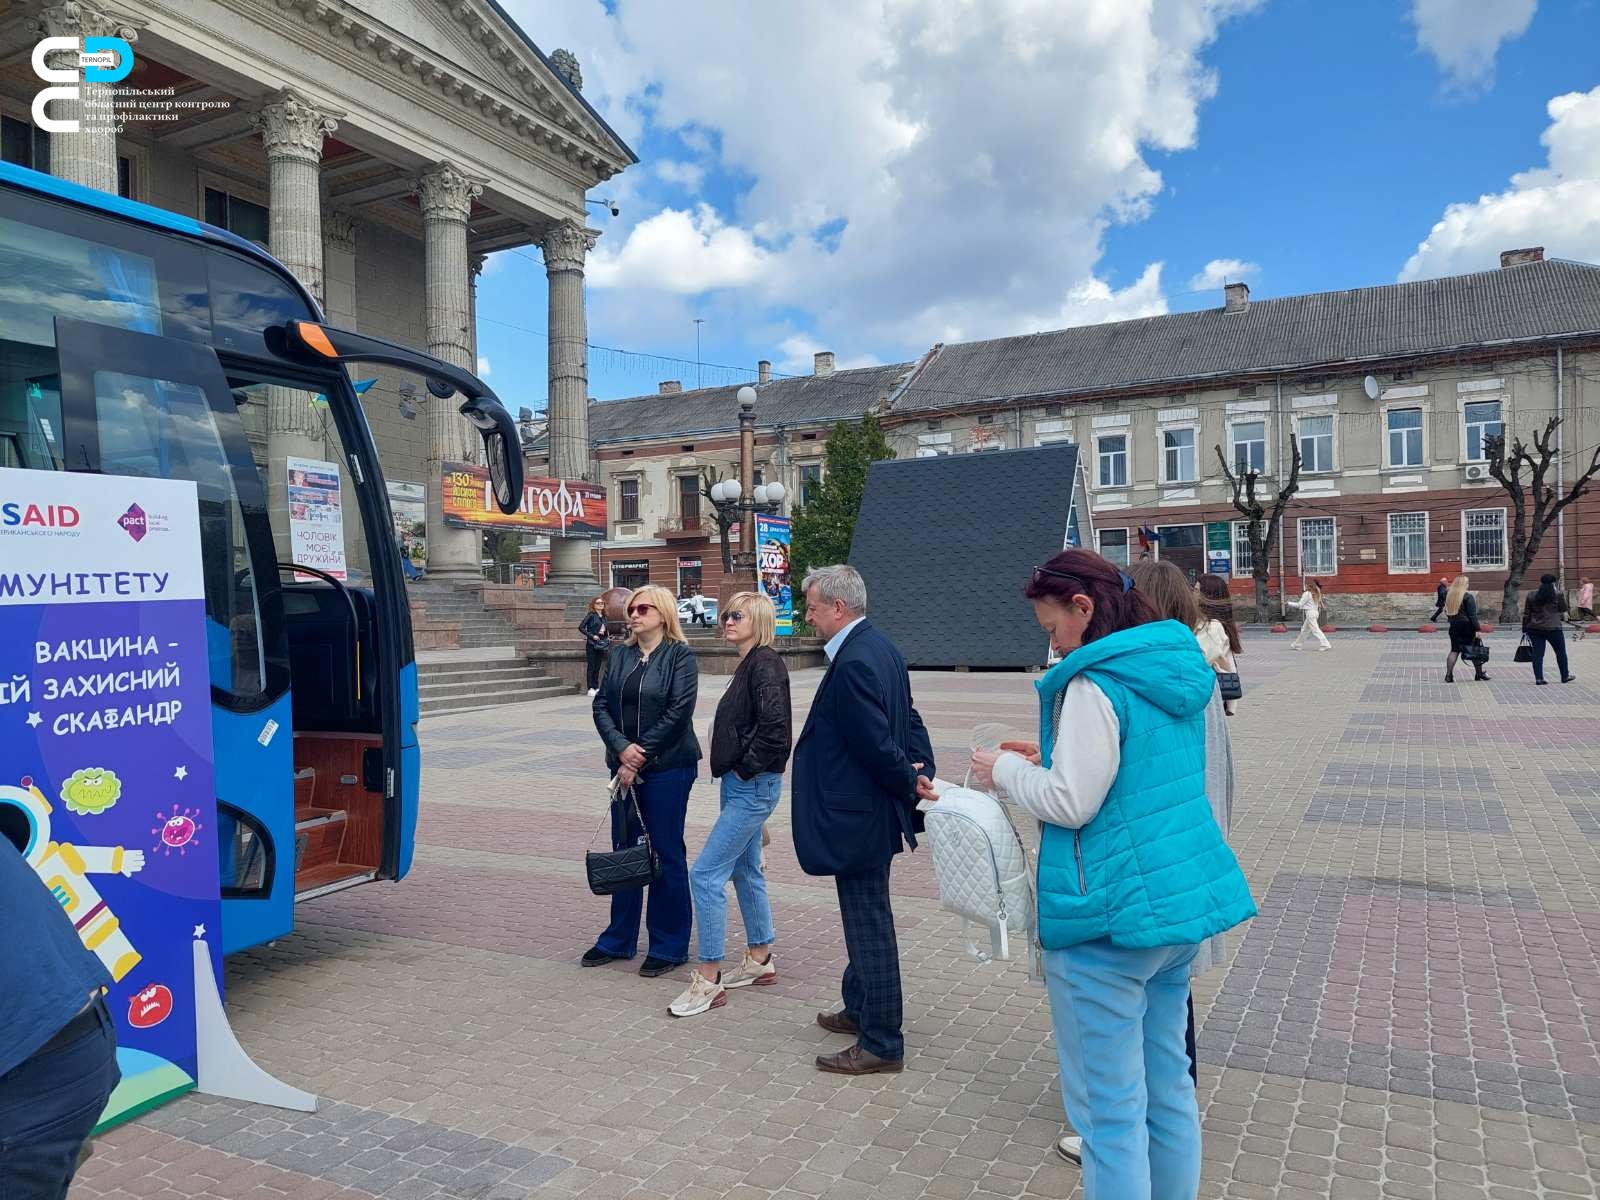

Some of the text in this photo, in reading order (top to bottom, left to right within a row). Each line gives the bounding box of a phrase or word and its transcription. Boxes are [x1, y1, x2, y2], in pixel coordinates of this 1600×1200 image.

[123, 517, 144, 527] pact
[297, 531, 337, 542] ЧОЛОВІК
[297, 553, 341, 564] ДРУЖИНИ
[761, 553, 784, 568] ХОР
[35, 636, 159, 663] ВАКЦИНА
[43, 661, 180, 700] ЗАХИСНИЙ
[53, 700, 182, 736] СКАФАНДР
